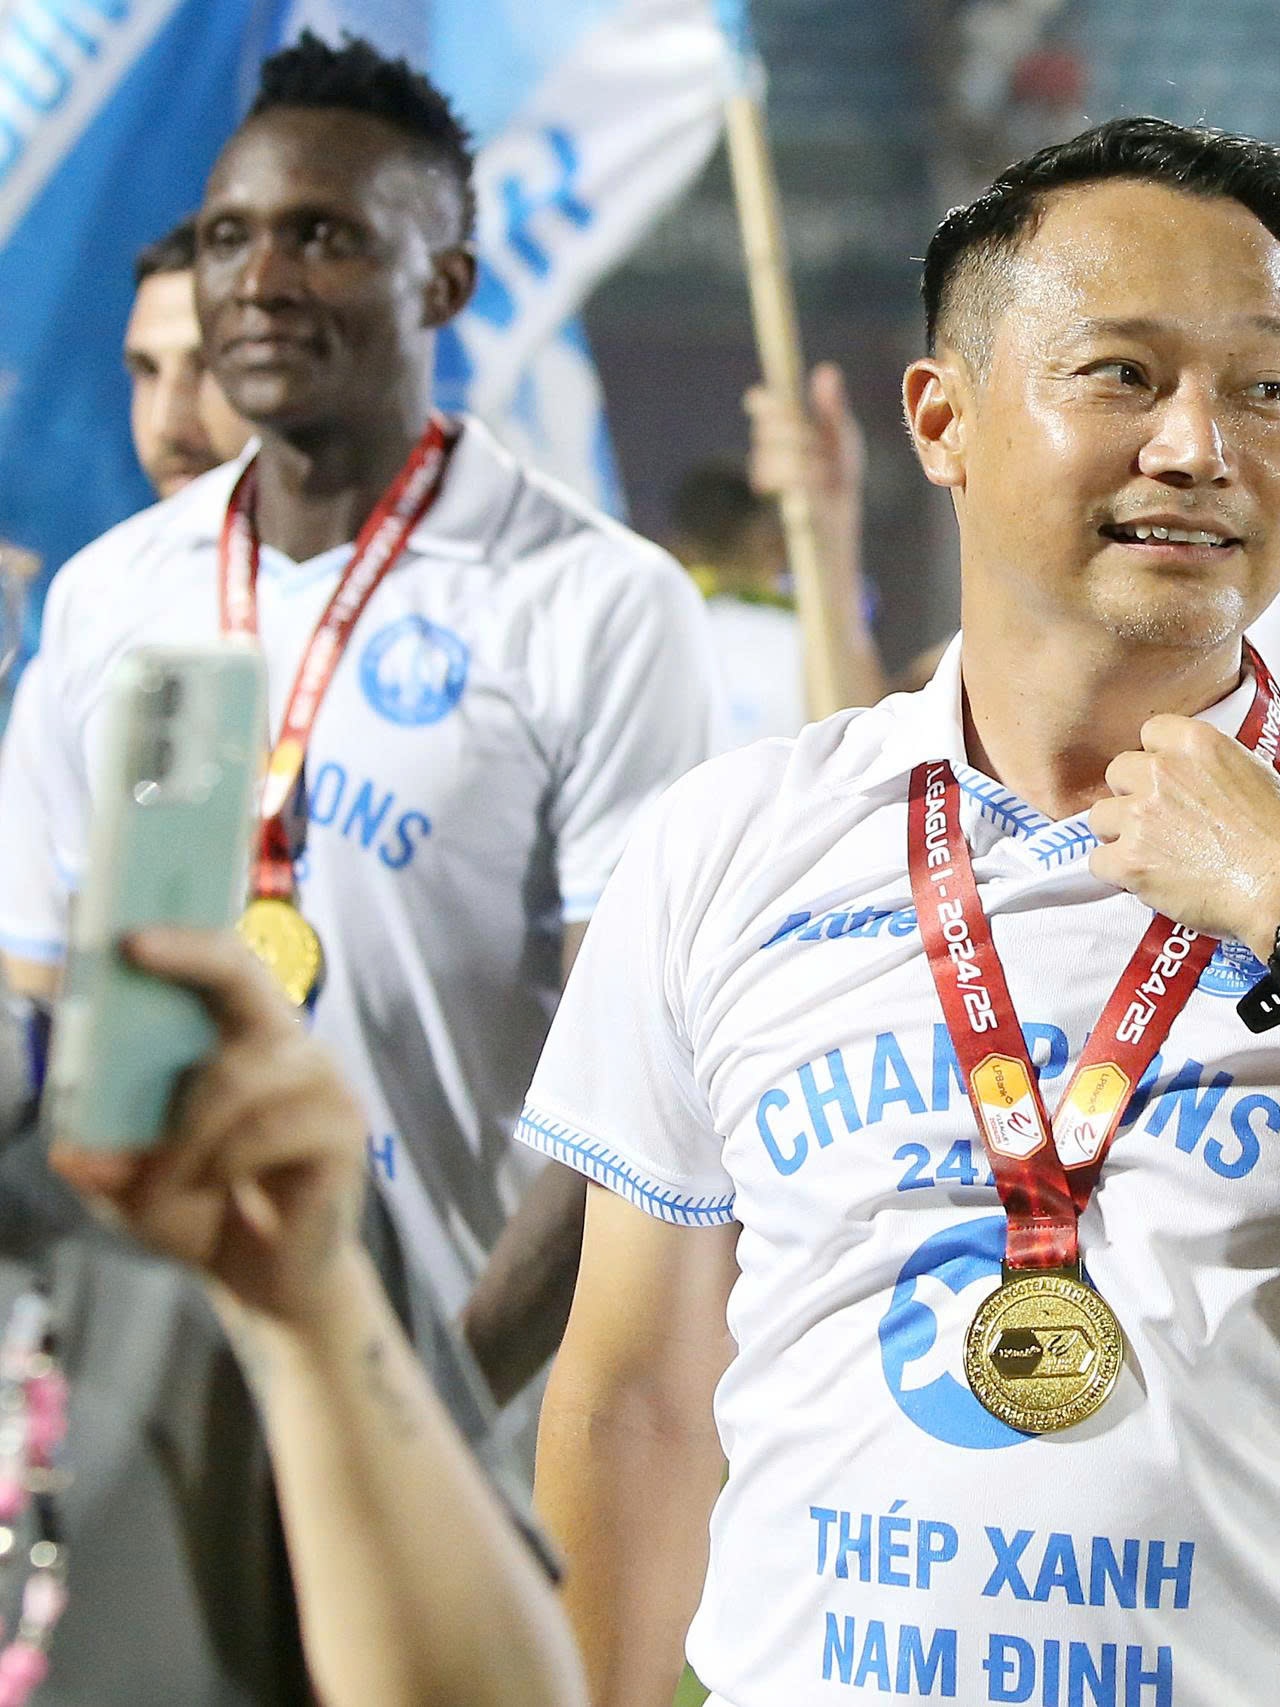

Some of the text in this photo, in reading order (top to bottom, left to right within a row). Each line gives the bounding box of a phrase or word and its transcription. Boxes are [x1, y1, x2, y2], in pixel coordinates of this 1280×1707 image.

[925, 764, 951, 869] .LEAGUE
[937, 898, 998, 1033] 2024/25
[809, 1500, 1196, 1610] THÉP XANH
[821, 1612, 957, 1697] NAM
